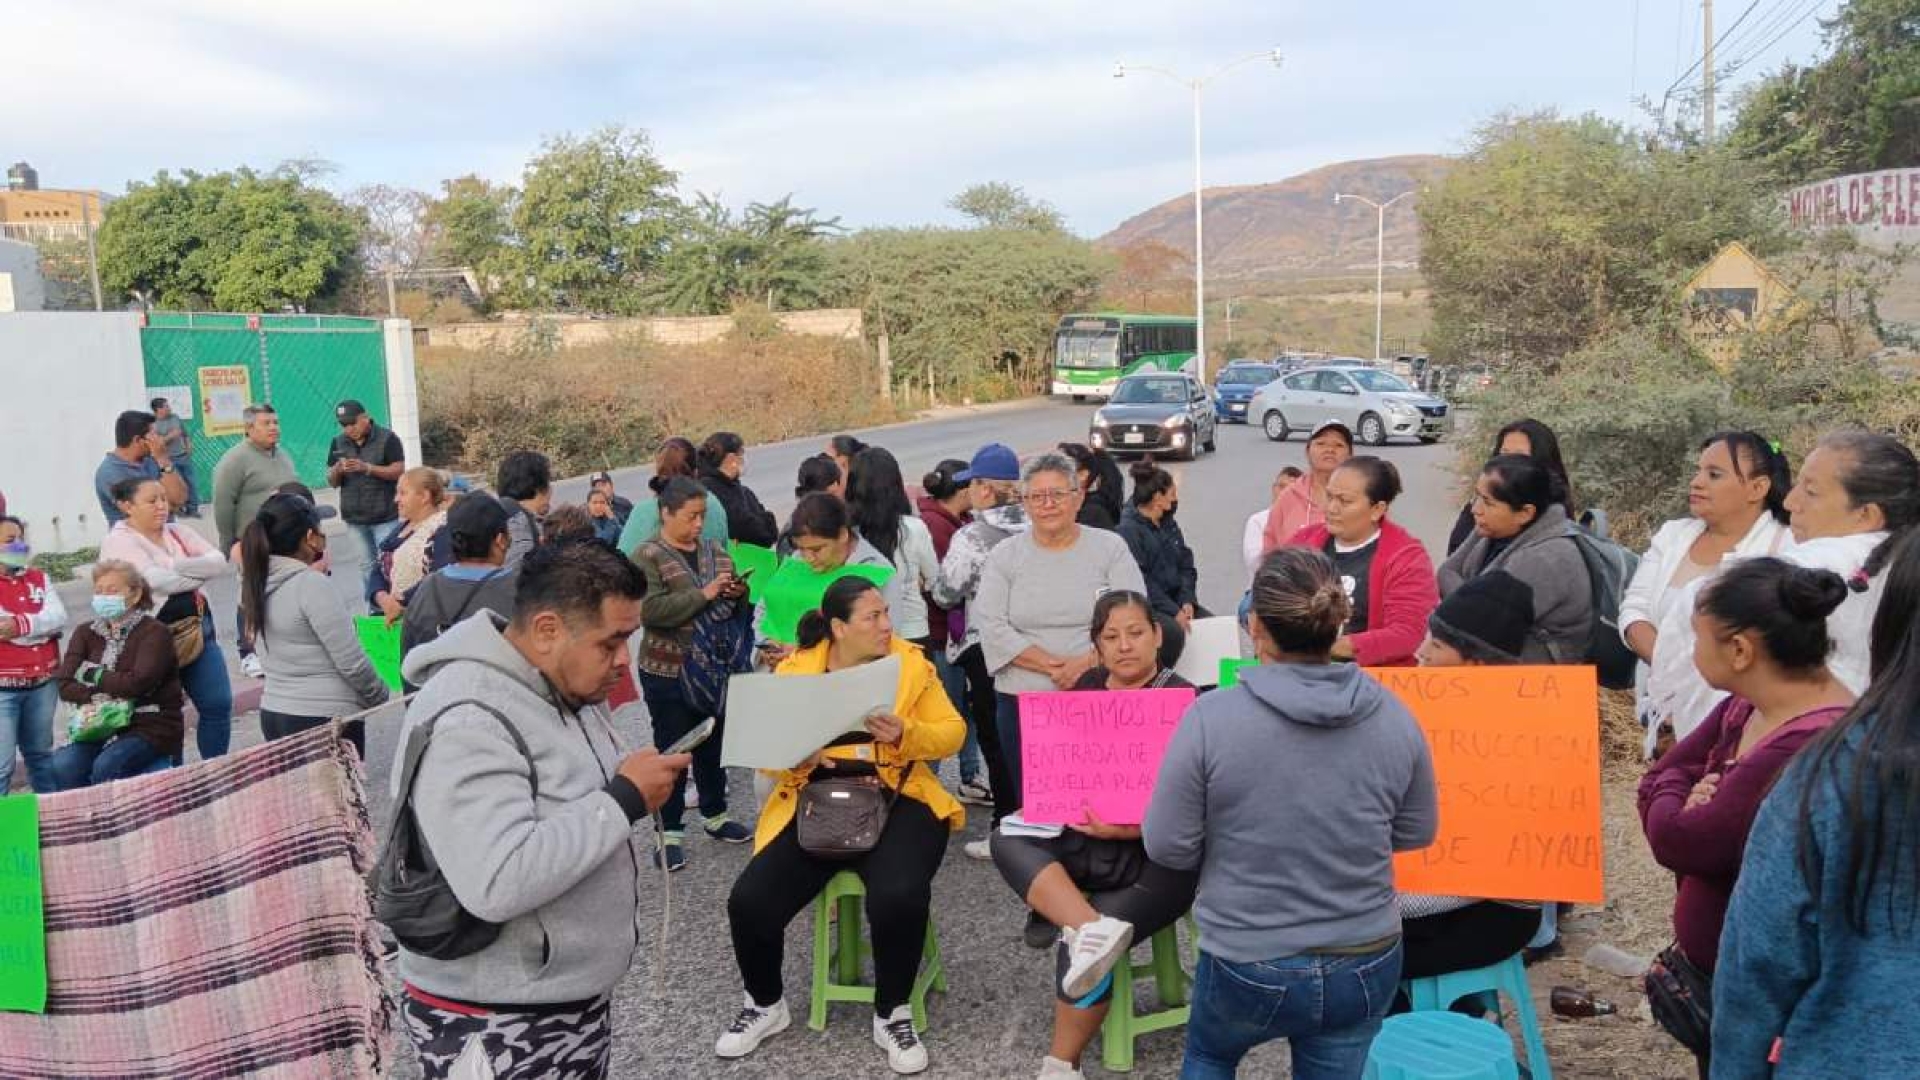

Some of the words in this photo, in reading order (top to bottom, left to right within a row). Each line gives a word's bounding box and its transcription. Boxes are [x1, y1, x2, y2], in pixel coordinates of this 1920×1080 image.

[1790, 176, 1874, 228] MORELOS
[1881, 173, 1920, 226] ELE
[1517, 674, 1561, 699] LA
[1029, 696, 1145, 736] EXIGIMOS
[1028, 742, 1121, 768] ENTRADA
[1129, 742, 1154, 764] DE
[1426, 730, 1591, 765] TRUCCION
[1028, 772, 1104, 795] ESCUELA
[1113, 769, 1156, 791] PLA
[1436, 781, 1587, 811] ESCUELA
[1422, 836, 1472, 870] DE
[1505, 831, 1600, 872] AYALA
